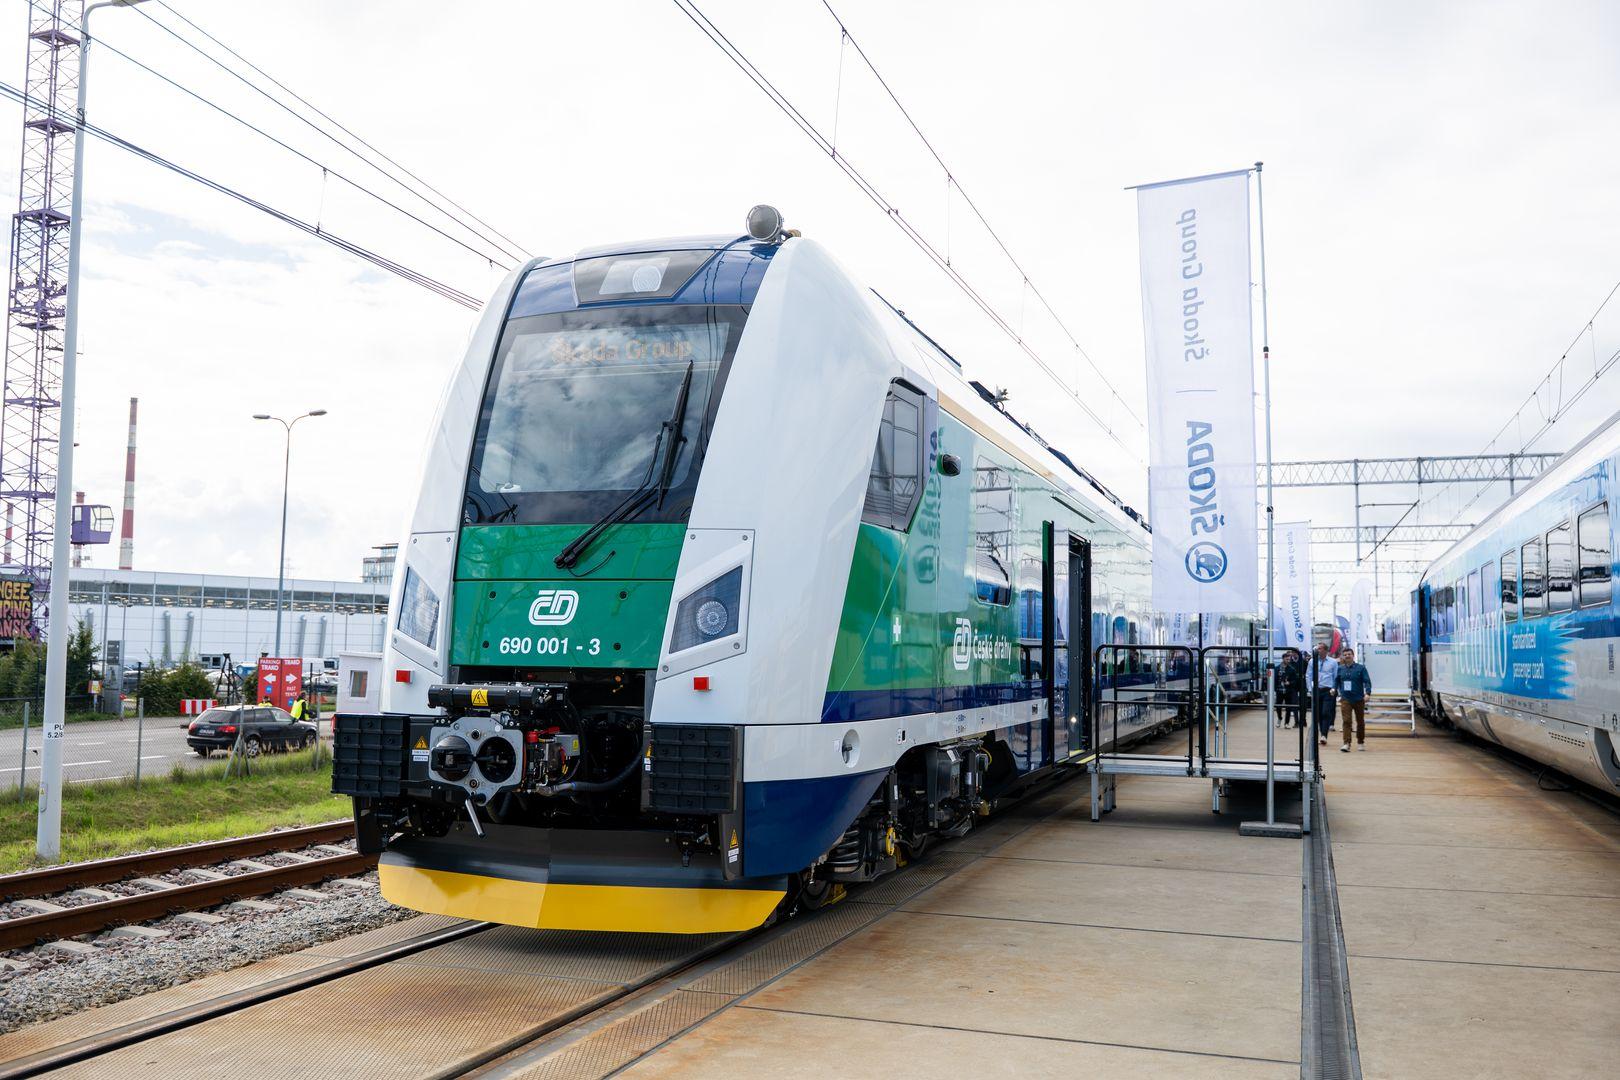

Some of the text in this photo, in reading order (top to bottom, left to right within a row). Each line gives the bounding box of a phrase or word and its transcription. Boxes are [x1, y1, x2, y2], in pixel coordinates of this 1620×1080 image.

[624, 338, 693, 361] Group
[0, 600, 31, 620] PING
[499, 637, 532, 655] 690
[537, 637, 569, 655] 001
[588, 638, 601, 656] 3
